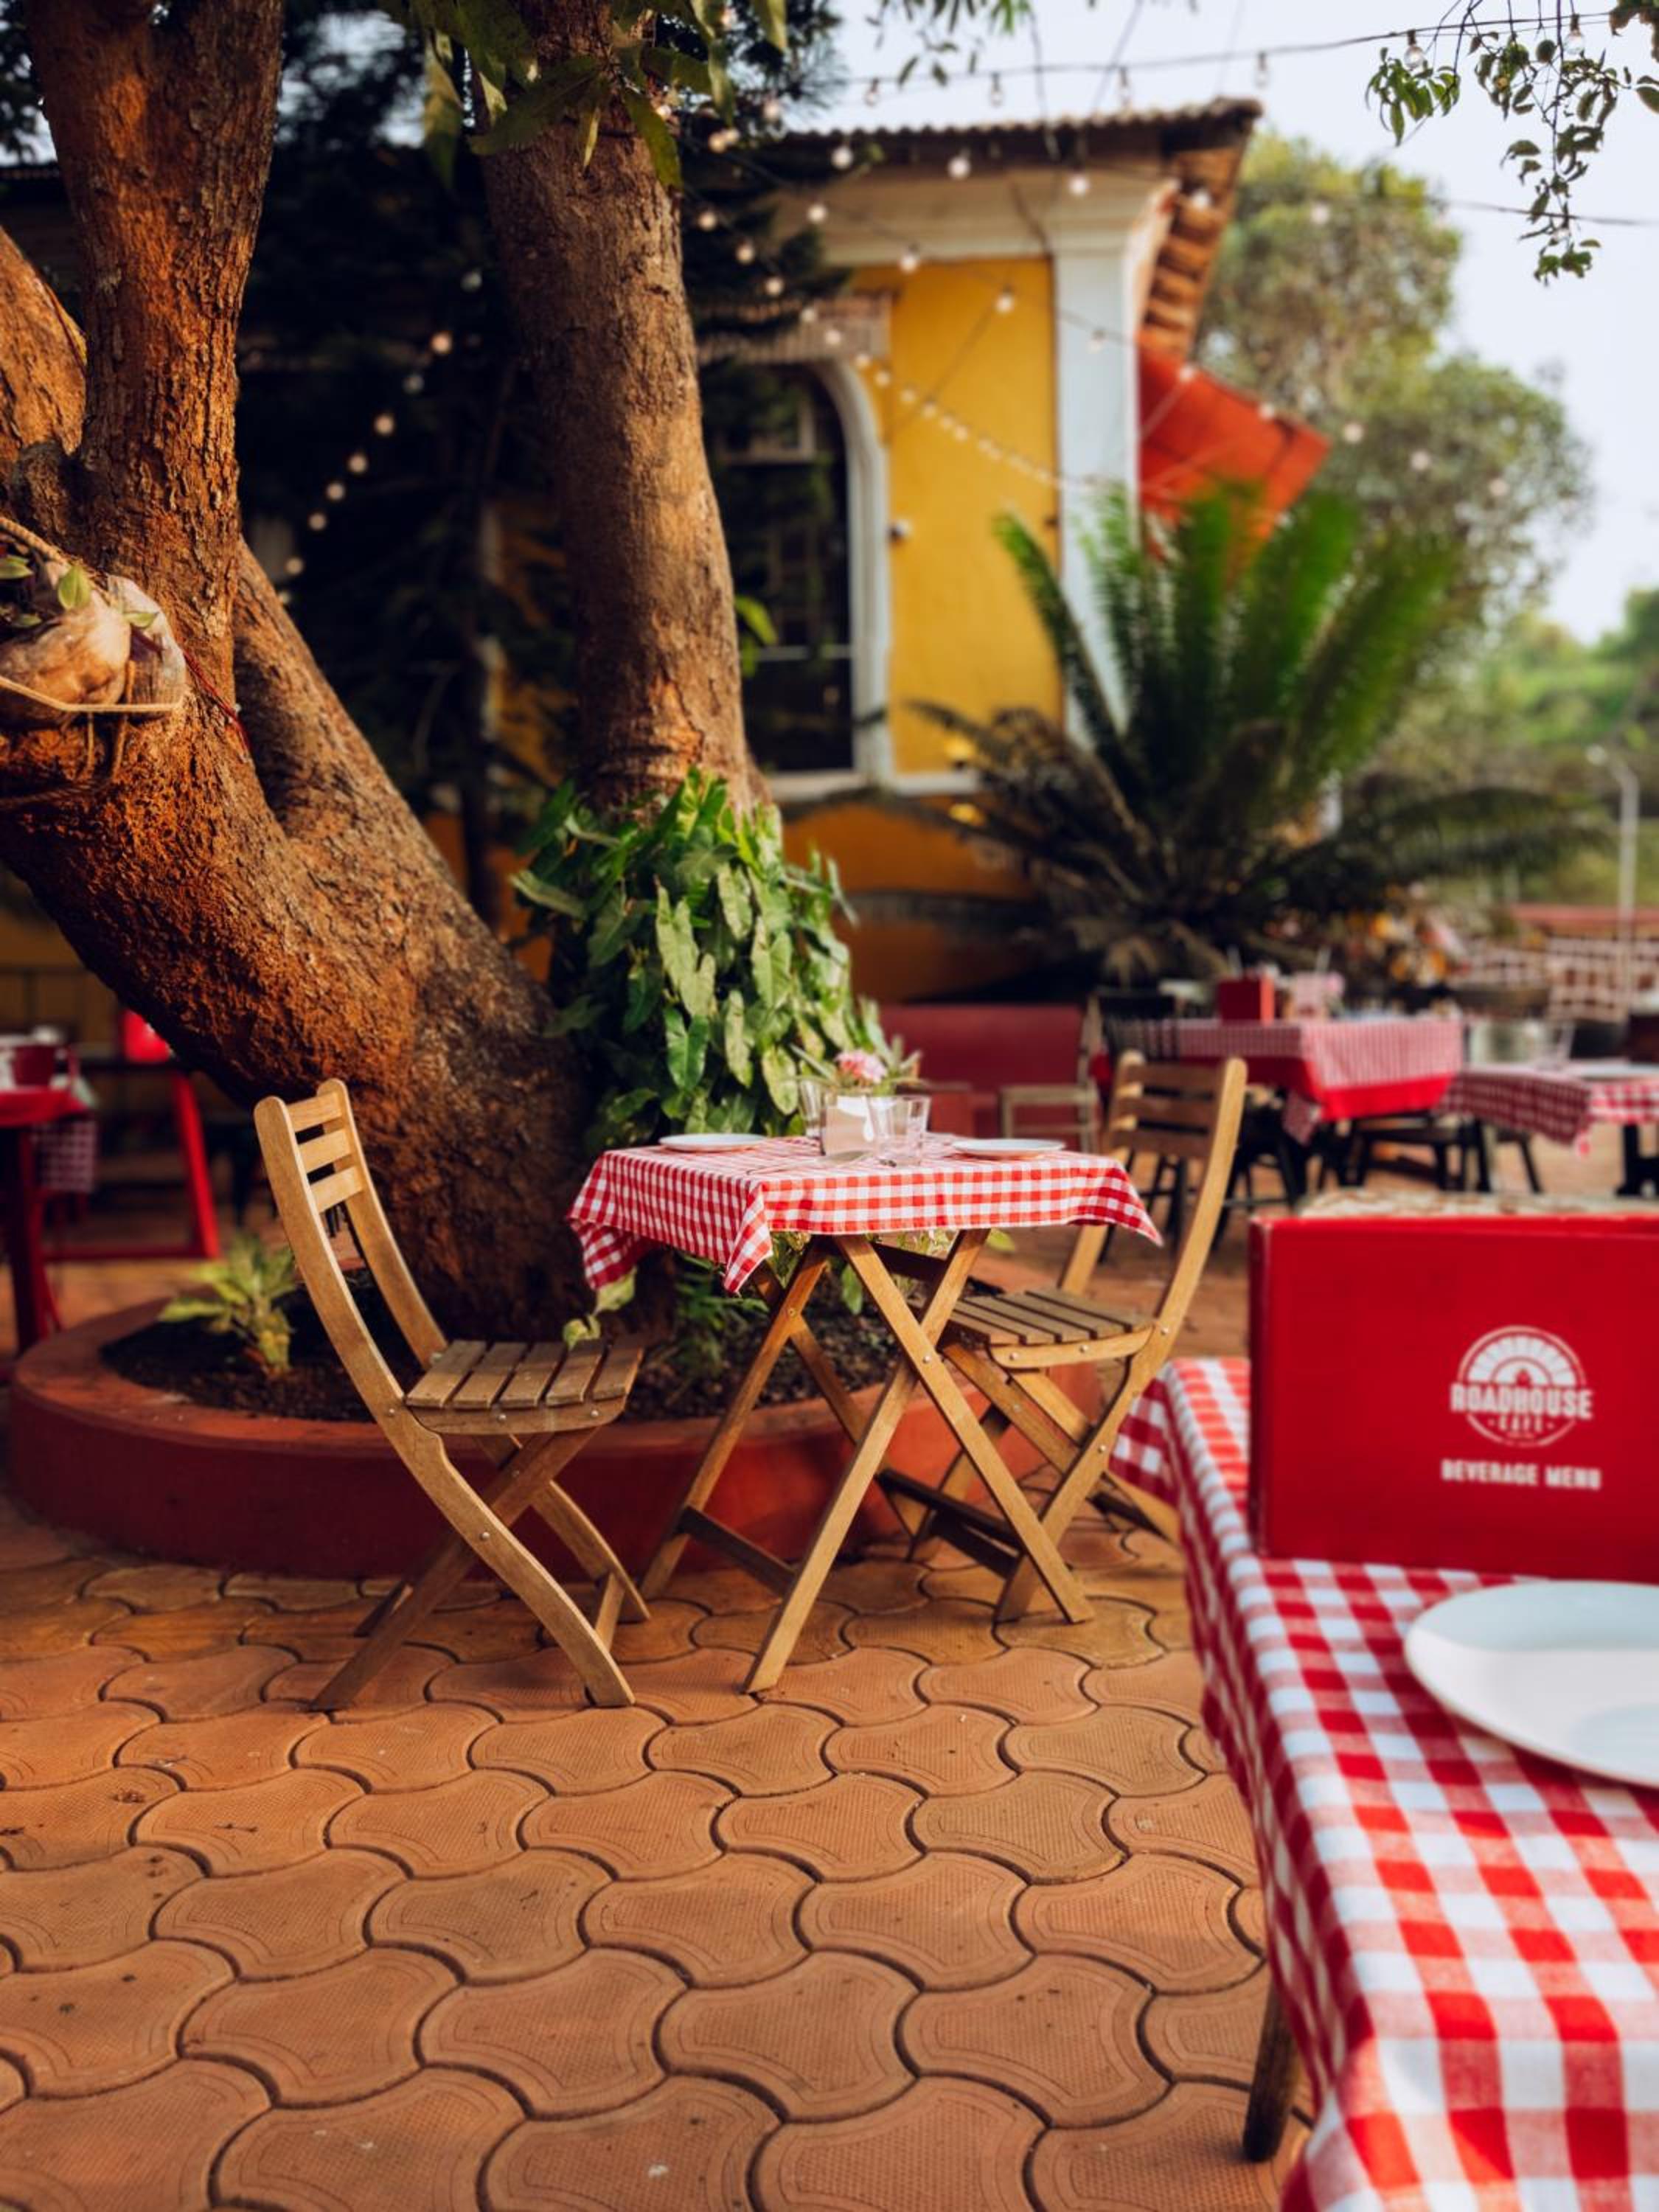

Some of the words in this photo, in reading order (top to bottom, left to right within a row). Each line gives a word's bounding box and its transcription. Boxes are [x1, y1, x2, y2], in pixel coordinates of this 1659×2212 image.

[1450, 1382, 1593, 1419] ROADHOUSE
[1441, 1459, 1538, 1486] BEVERAGE
[1545, 1466, 1602, 1491] MENU
